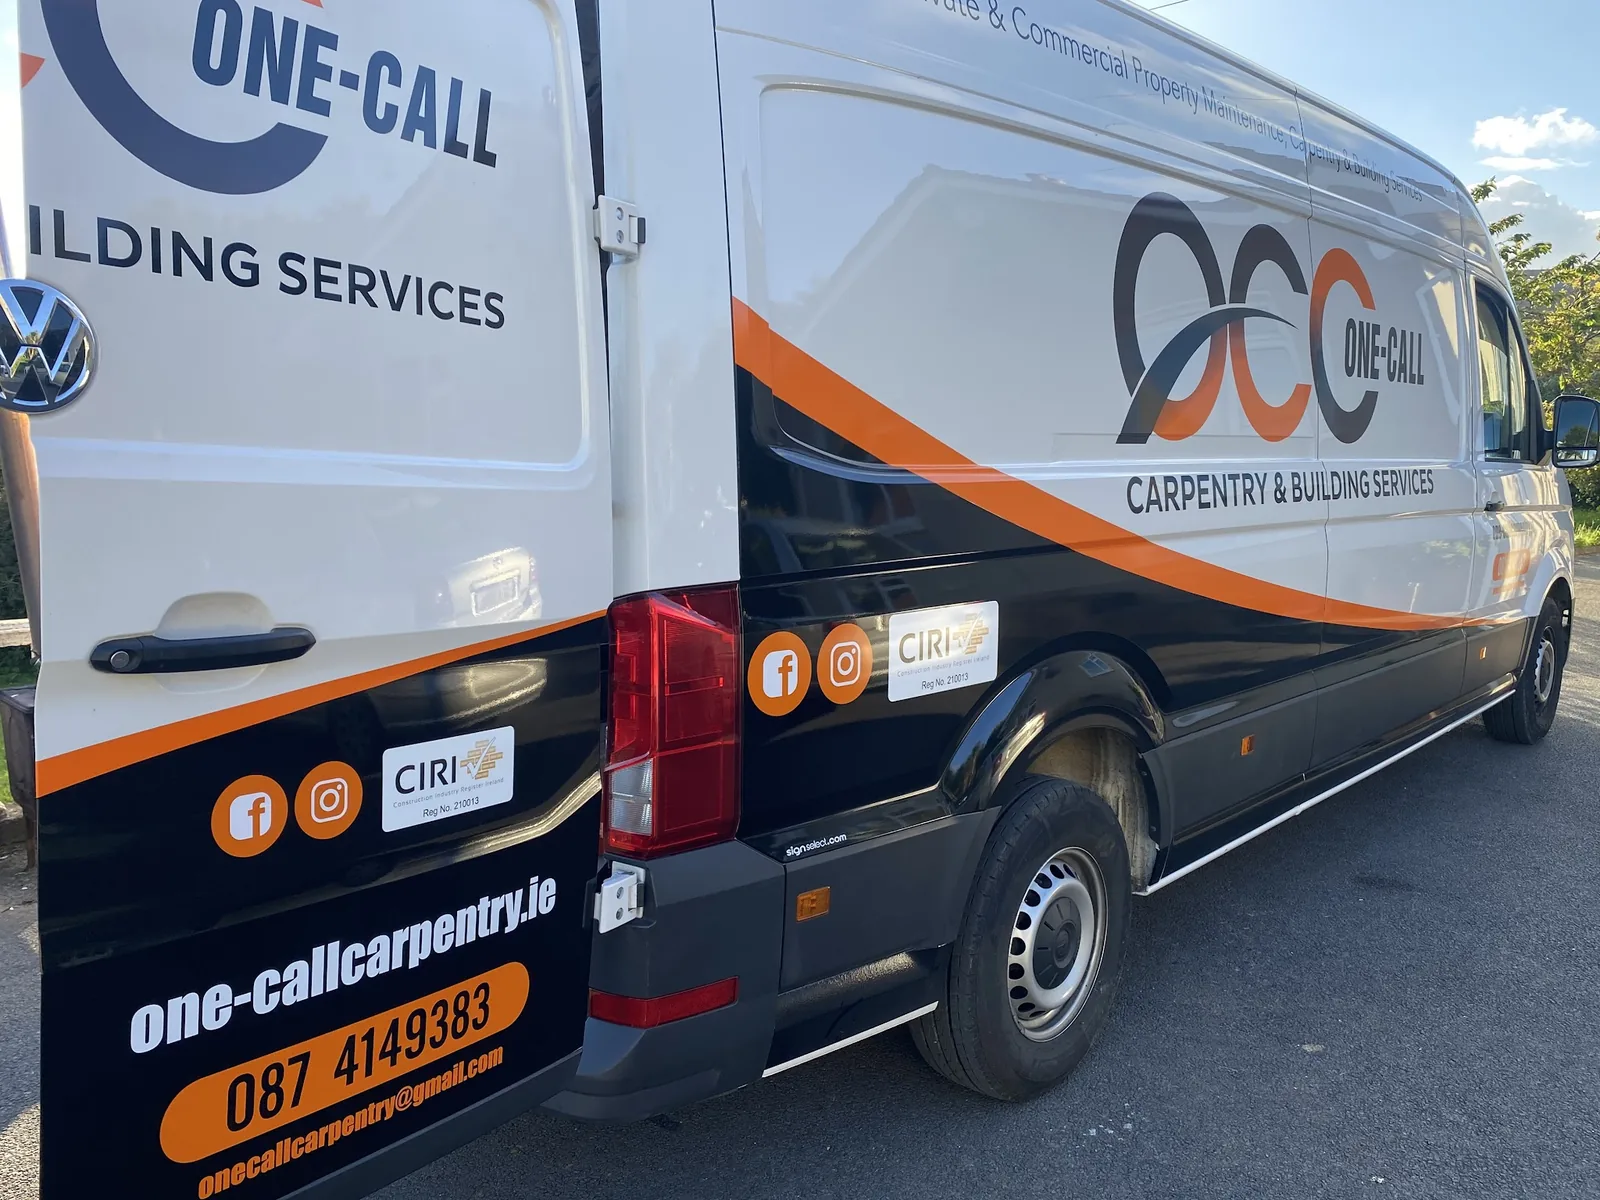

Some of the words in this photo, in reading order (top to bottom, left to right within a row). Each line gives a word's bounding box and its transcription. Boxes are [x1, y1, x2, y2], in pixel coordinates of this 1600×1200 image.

[192, 0, 498, 168] ONE-CALL
[987, 0, 1007, 31] &
[1011, 6, 1128, 79] Commercial
[1132, 56, 1199, 115] Property
[1201, 85, 1288, 149] Maintenance,
[1289, 126, 1340, 173] Capentry
[1352, 152, 1390, 193] Building
[1390, 170, 1423, 202] Services
[278, 252, 506, 329] SERVICES
[1344, 317, 1425, 385] ONE-CALL
[1126, 473, 1268, 514] CARPENTRY
[1273, 472, 1287, 504] &
[1292, 470, 1370, 502] BUILDING
[1373, 469, 1434, 497] SERVICES
[899, 628, 950, 663] CIRI
[922, 680, 935, 690] Reg
[936, 677, 946, 687] No.
[947, 672, 969, 685] 210013
[393, 794, 433, 808] Construction
[434, 788, 459, 800] Industry
[460, 782, 484, 794] Register
[485, 777, 504, 787] Ireland
[395, 755, 457, 794] CIRI
[423, 807, 438, 818] Reg
[439, 803, 452, 815] No.
[454, 796, 480, 810] 210013
[785, 833, 848, 857] signselect.com
[130, 875, 556, 1054] one-callcarpentry.ie
[226, 1051, 312, 1132] 087
[333, 982, 490, 1086] 4149383
[198, 1046, 504, 1200] onecallcarpentry@gmail.com
